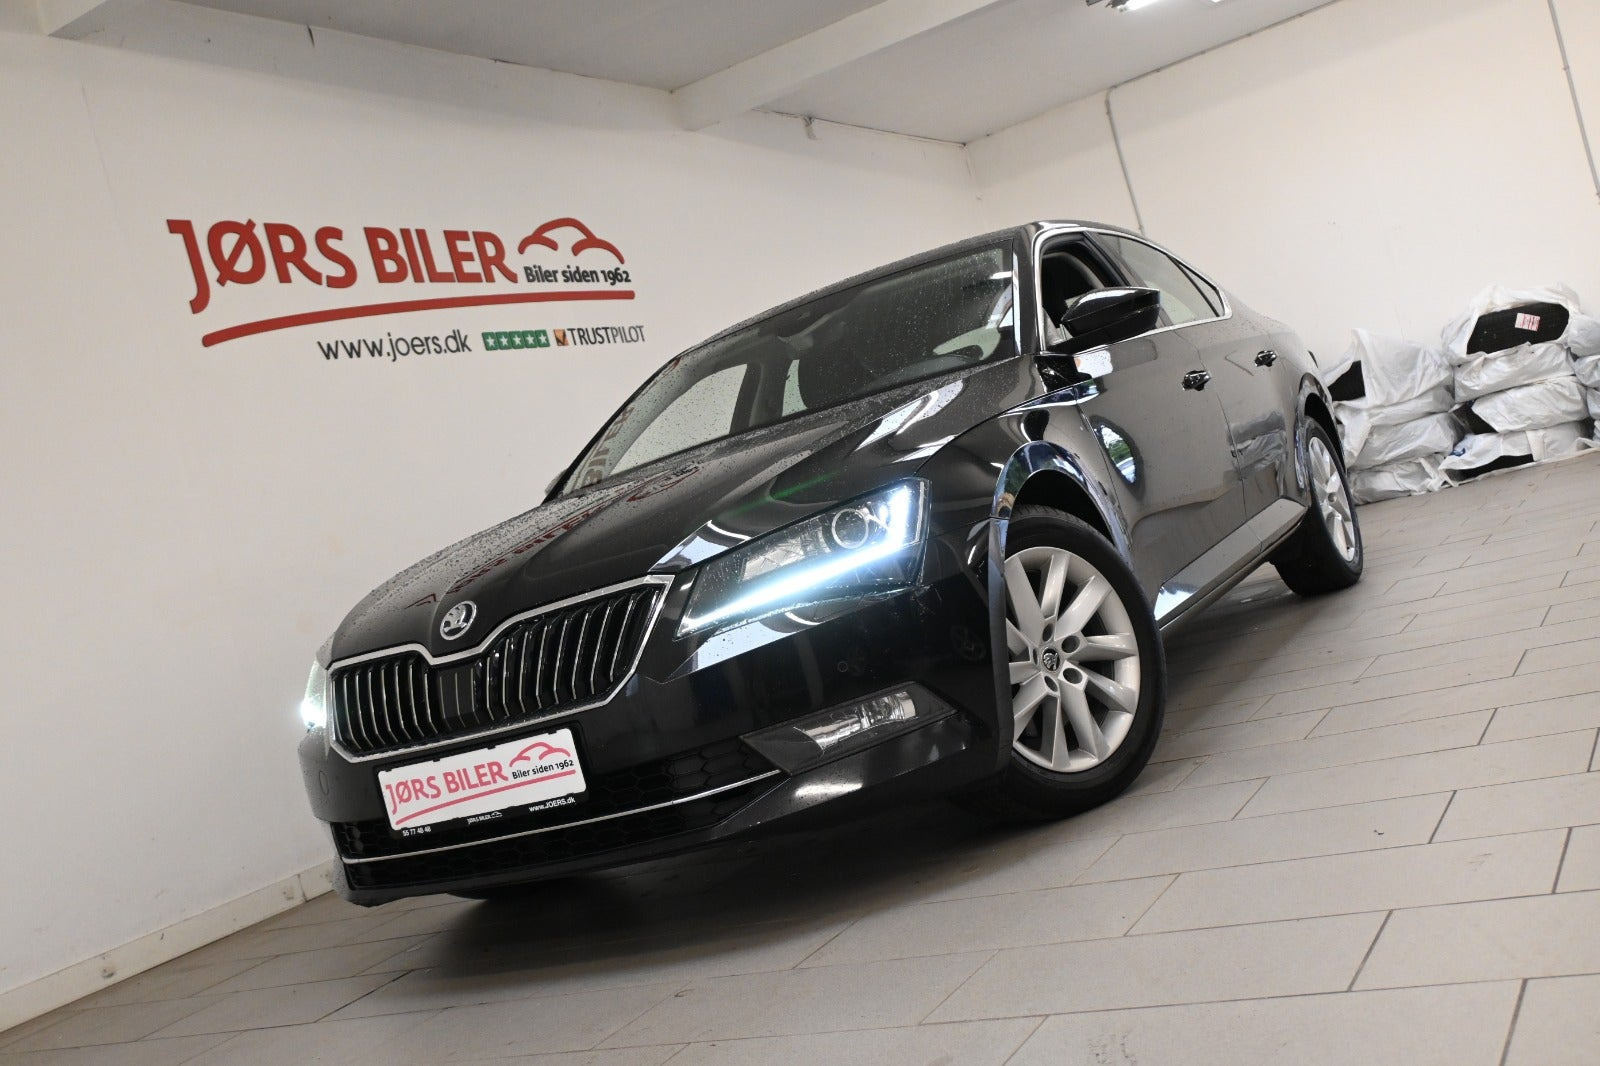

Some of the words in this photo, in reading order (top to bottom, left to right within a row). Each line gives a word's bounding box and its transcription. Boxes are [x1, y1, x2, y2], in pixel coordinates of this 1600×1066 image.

[167, 219, 358, 314] JØRS
[364, 226, 518, 283] BILER
[523, 264, 559, 284] Biler
[561, 264, 600, 283] siden
[600, 267, 632, 286] 1962
[317, 329, 472, 363] www.joers.dk
[567, 325, 646, 347] TRUSTPILOT
[511, 769, 531, 780] Biler
[532, 764, 554, 775] siden
[555, 759, 574, 770] 1962
[385, 776, 442, 815] JØRS
[443, 761, 509, 794] BILER
[528, 796, 576, 812] www.JOERS.dk
